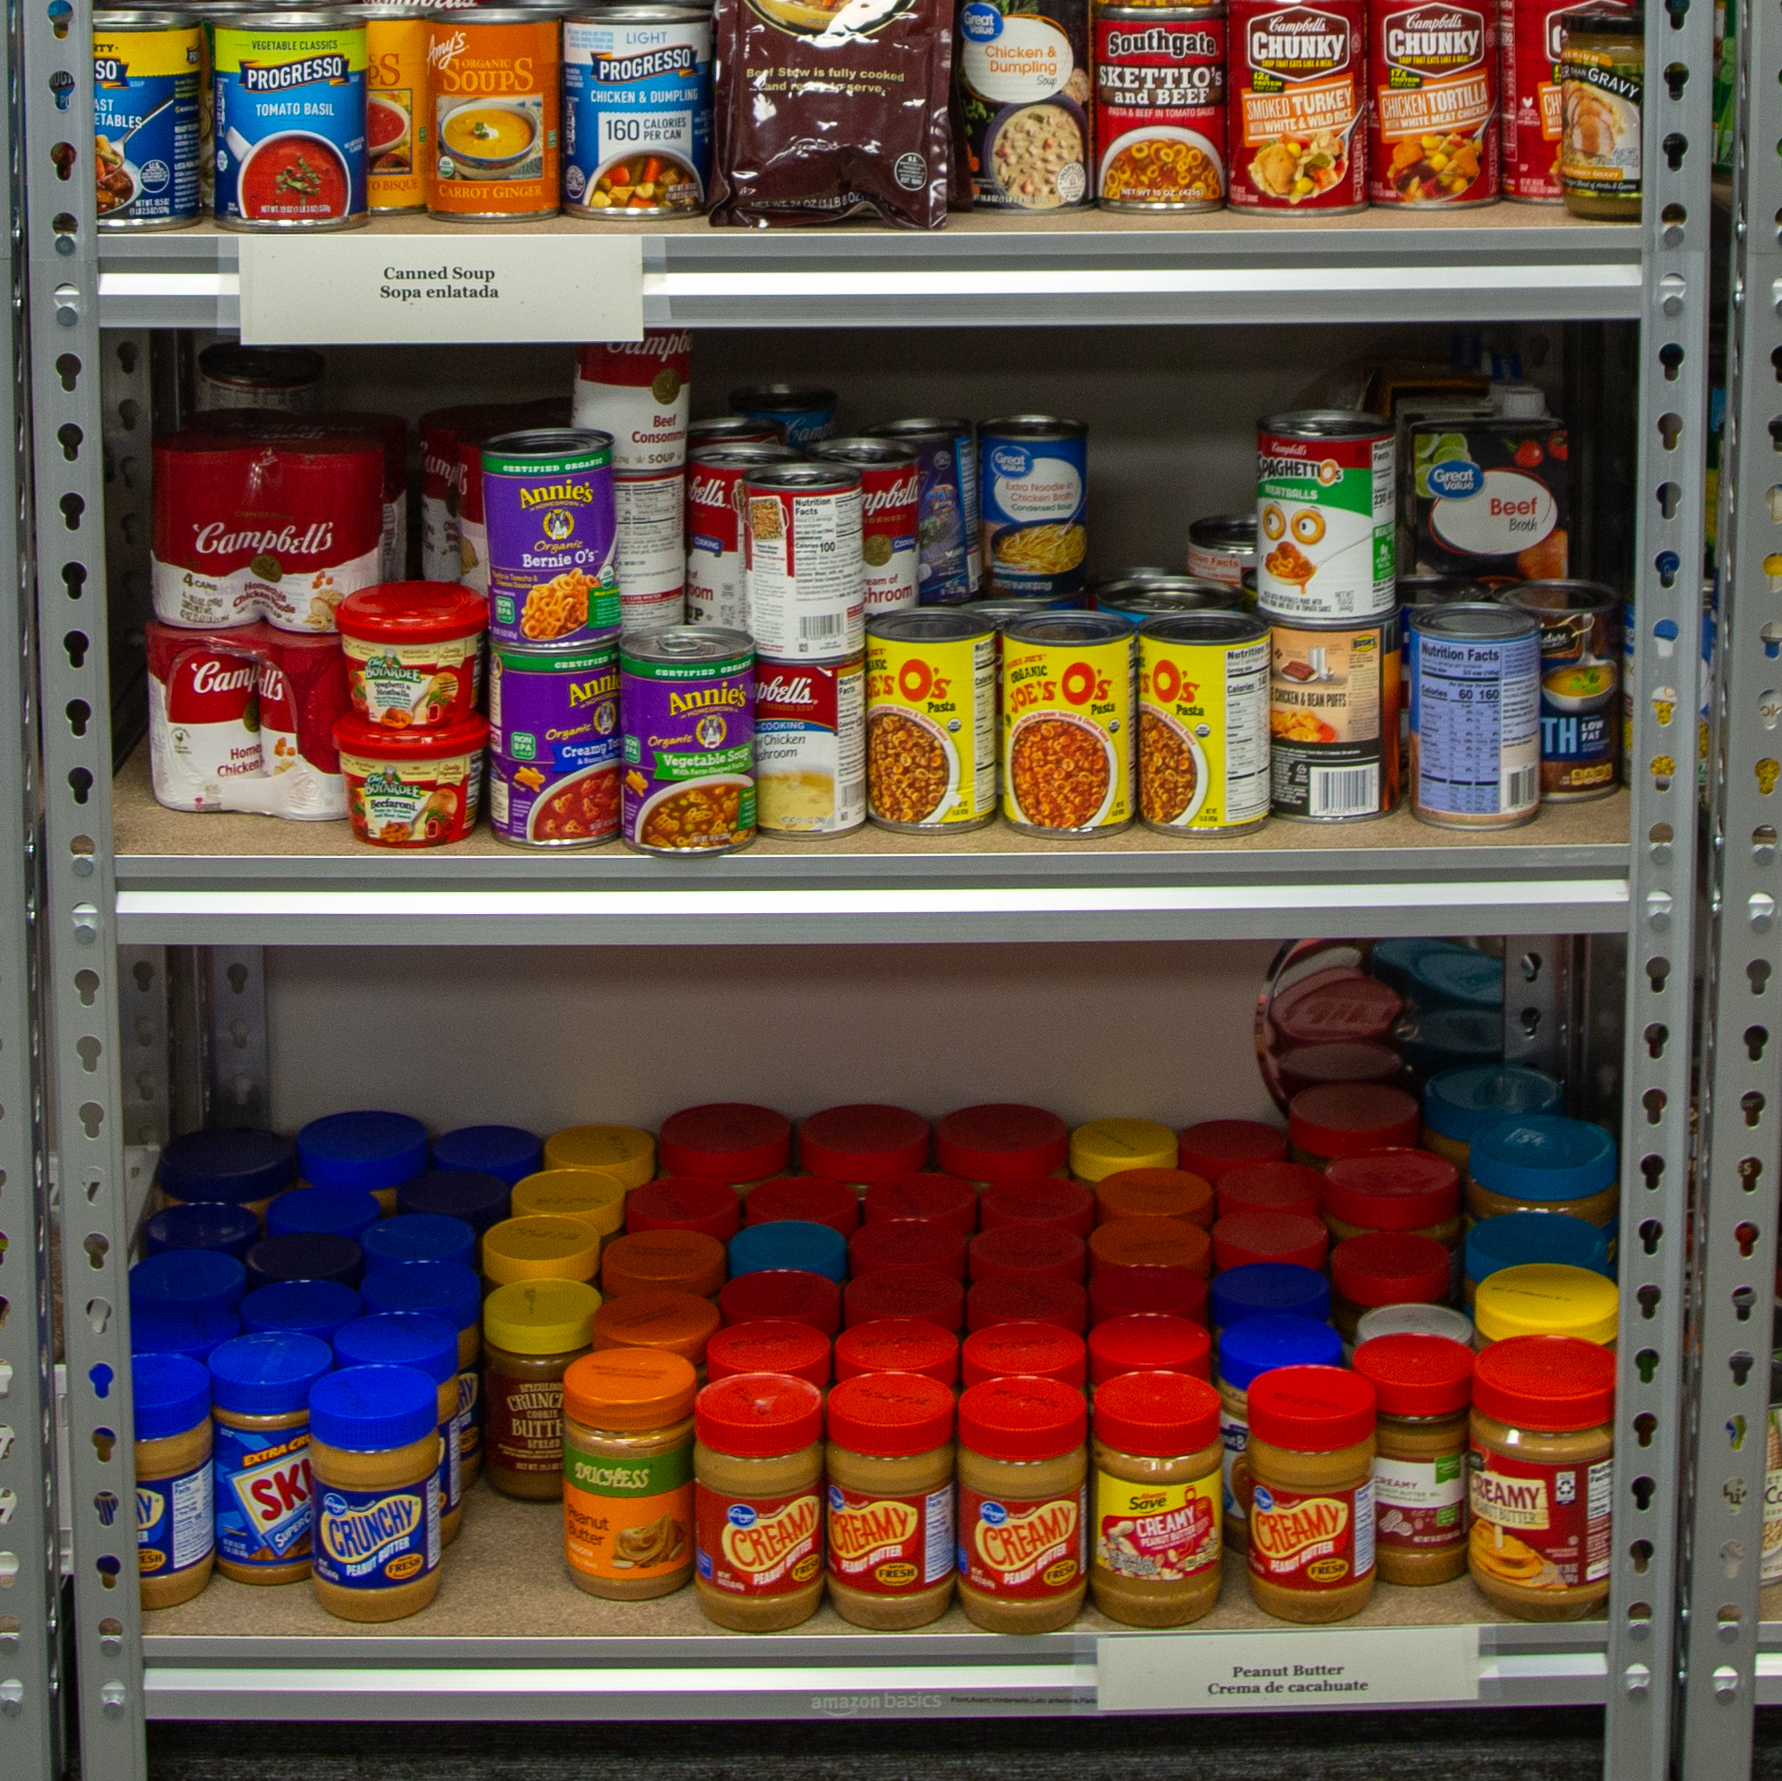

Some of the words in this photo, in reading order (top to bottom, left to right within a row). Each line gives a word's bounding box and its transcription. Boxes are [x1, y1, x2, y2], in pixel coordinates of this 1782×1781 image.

[626, 31, 667, 45] LIGHT
[985, 45, 1043, 60] Chicken
[1047, 47, 1057, 59] &
[247, 58, 343, 90] PROGRESSO
[989, 60, 1058, 75] Dumpling
[256, 104, 299, 117] TOMATO
[303, 103, 335, 116] BASIL
[605, 120, 639, 140] 160
[643, 117, 687, 130] CALORIES
[383, 266, 449, 281] Canned
[453, 267, 495, 282] Soup
[379, 286, 421, 301] Sopa
[425, 286, 499, 299] enlatada
[520, 481, 594, 511] Annie's
[1490, 498, 1538, 516] Beef
[1508, 518, 1537, 532] Broth
[522, 553, 571, 569] Bernie
[576, 549, 594, 567] O's
[1091, 703, 1116, 715] Pasta
[1581, 721, 1604, 731] LOW
[1581, 730, 1600, 740] FAT
[663, 753, 718, 767] Vegetable
[721, 749, 750, 765] Soup
[1129, 1493, 1167, 1511] Save
[328, 1501, 416, 1559] CRUNCHY
[827, 1505, 908, 1553] CREAMY
[1135, 1505, 1196, 1539] CREAMY
[387, 1559, 422, 1575] FRESH
[840, 1558, 869, 1573] PEANUT
[870, 1545, 902, 1566] BUTTER
[1233, 1665, 1290, 1678] Peanut
[1292, 1664, 1344, 1677] Butter
[1208, 1681, 1262, 1695] Crema
[1265, 1681, 1283, 1694] de
[1287, 1679, 1369, 1694] cacahuate
[811, 1694, 880, 1710] amazon
[884, 1693, 941, 1708] basics
